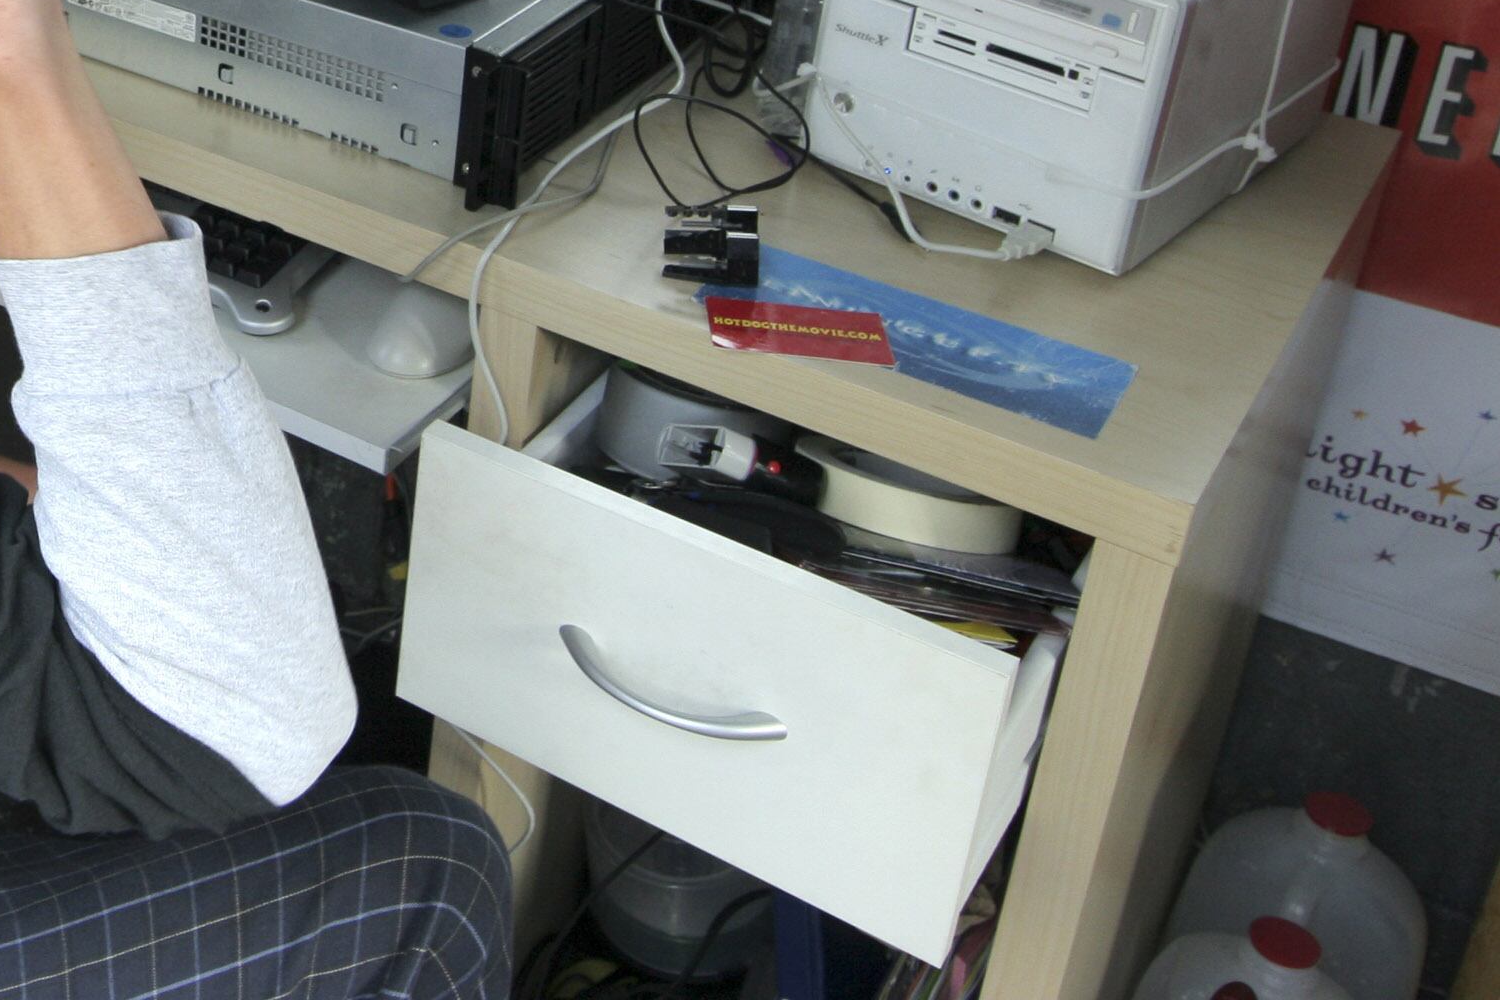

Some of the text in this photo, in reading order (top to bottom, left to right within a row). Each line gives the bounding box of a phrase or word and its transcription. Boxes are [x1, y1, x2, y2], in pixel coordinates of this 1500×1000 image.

[1330, 23, 1490, 158] NE
[713, 316, 882, 341] HOTDOGTHEMOVIE.COM
[1306, 476, 1471, 534] children's
